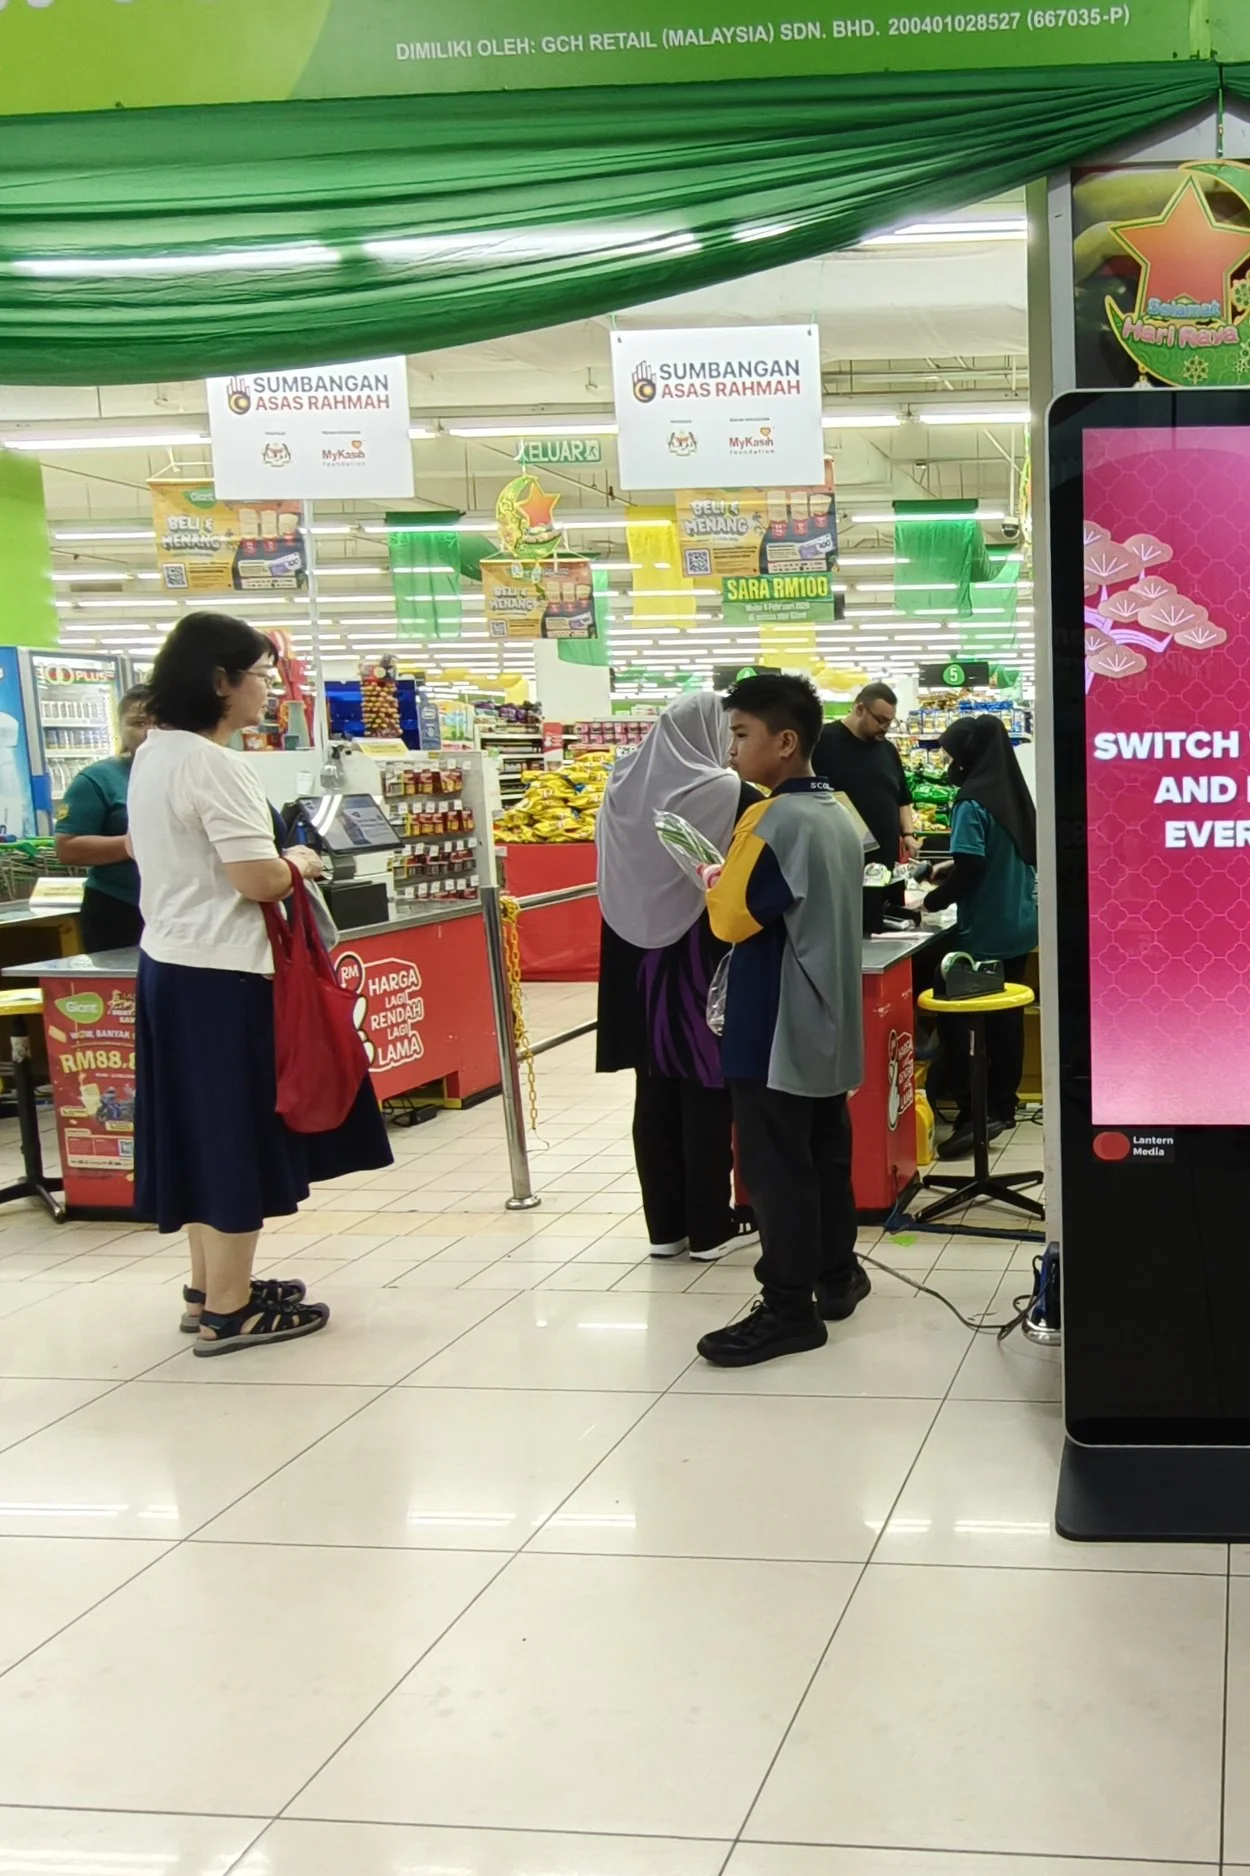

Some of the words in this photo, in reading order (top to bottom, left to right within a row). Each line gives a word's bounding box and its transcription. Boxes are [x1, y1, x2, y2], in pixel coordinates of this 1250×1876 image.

[396, 40, 472, 61] DIMILIKI
[477, 36, 535, 57] OLEH:
[541, 34, 584, 53] GCH
[590, 31, 657, 50] RETAIL
[662, 22, 774, 49] (MALAYSIA)
[780, 23, 827, 41] SDN.
[833, 20, 880, 38] BHD.
[888, 12, 1020, 35] 200401028527
[1027, 4, 1130, 31] (667035-P)
[1147, 297, 1221, 318] Selamat
[1121, 315, 1175, 348] Hari
[1179, 325, 1239, 348] Raya
[659, 359, 800, 381] SUMBANGAN
[253, 374, 389, 394] SUMBANGAN
[661, 382, 711, 399] ASAS
[715, 379, 801, 397] RAHMAH
[255, 395, 303, 411] ASAS
[308, 394, 390, 411] RAHMAH
[728, 436, 774, 450] MyKasih
[322, 449, 366, 462] MyKasih
[690, 499, 725, 515] BELI
[167, 515, 200, 531] BELI
[684, 517, 749, 536] MENANG
[162, 534, 222, 551] MENANG
[726, 578, 770, 600] SARA
[773, 576, 829, 599] RM100
[76, 670, 108, 682] PLUS
[950, 667, 958, 682] 5
[1093, 730, 1240, 760] SWITCH
[1154, 775, 1238, 804] AND
[340, 964, 359, 984] RM
[368, 968, 418, 997] HARGA
[66, 1001, 99, 1013] Giant
[385, 992, 407, 1009] LAGI
[370, 1000, 422, 1031] RENDAH
[95, 1029, 130, 1039] BANYAK
[387, 1024, 410, 1041] LAGI
[377, 1036, 421, 1066] LAMA
[1132, 1135, 1174, 1145] Lantern
[1132, 1146, 1165, 1156] Media
